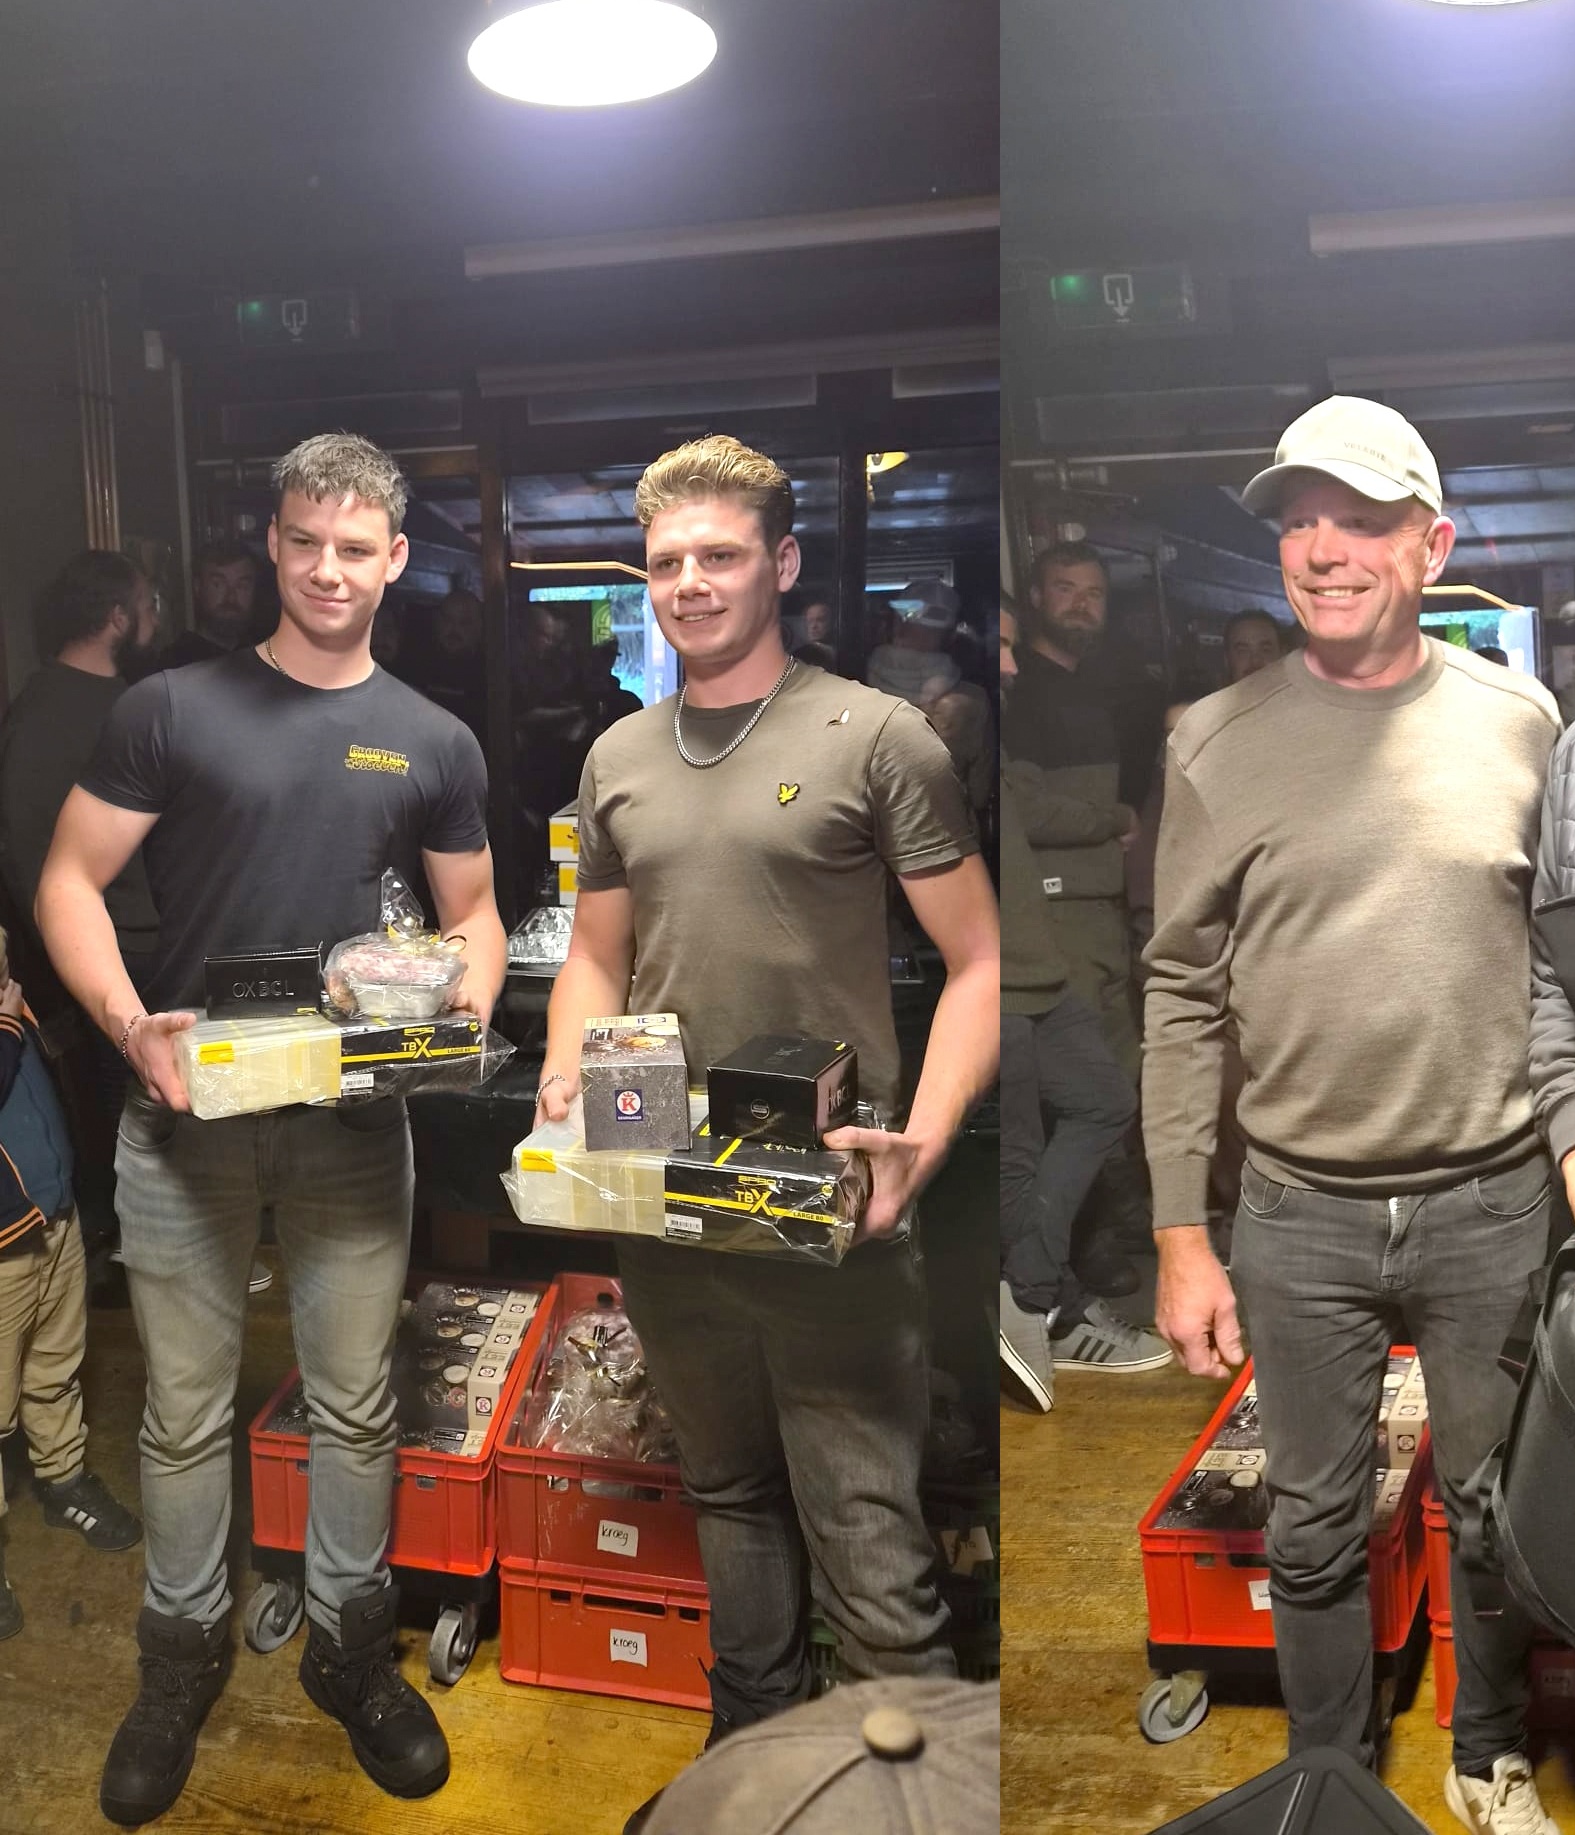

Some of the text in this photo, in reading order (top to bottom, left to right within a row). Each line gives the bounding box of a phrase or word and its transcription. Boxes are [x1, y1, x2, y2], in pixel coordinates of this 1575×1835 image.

[792, 1211, 815, 1220] LARGE
[601, 1523, 629, 1547] kroeg
[612, 1636, 639, 1656] kroeg
